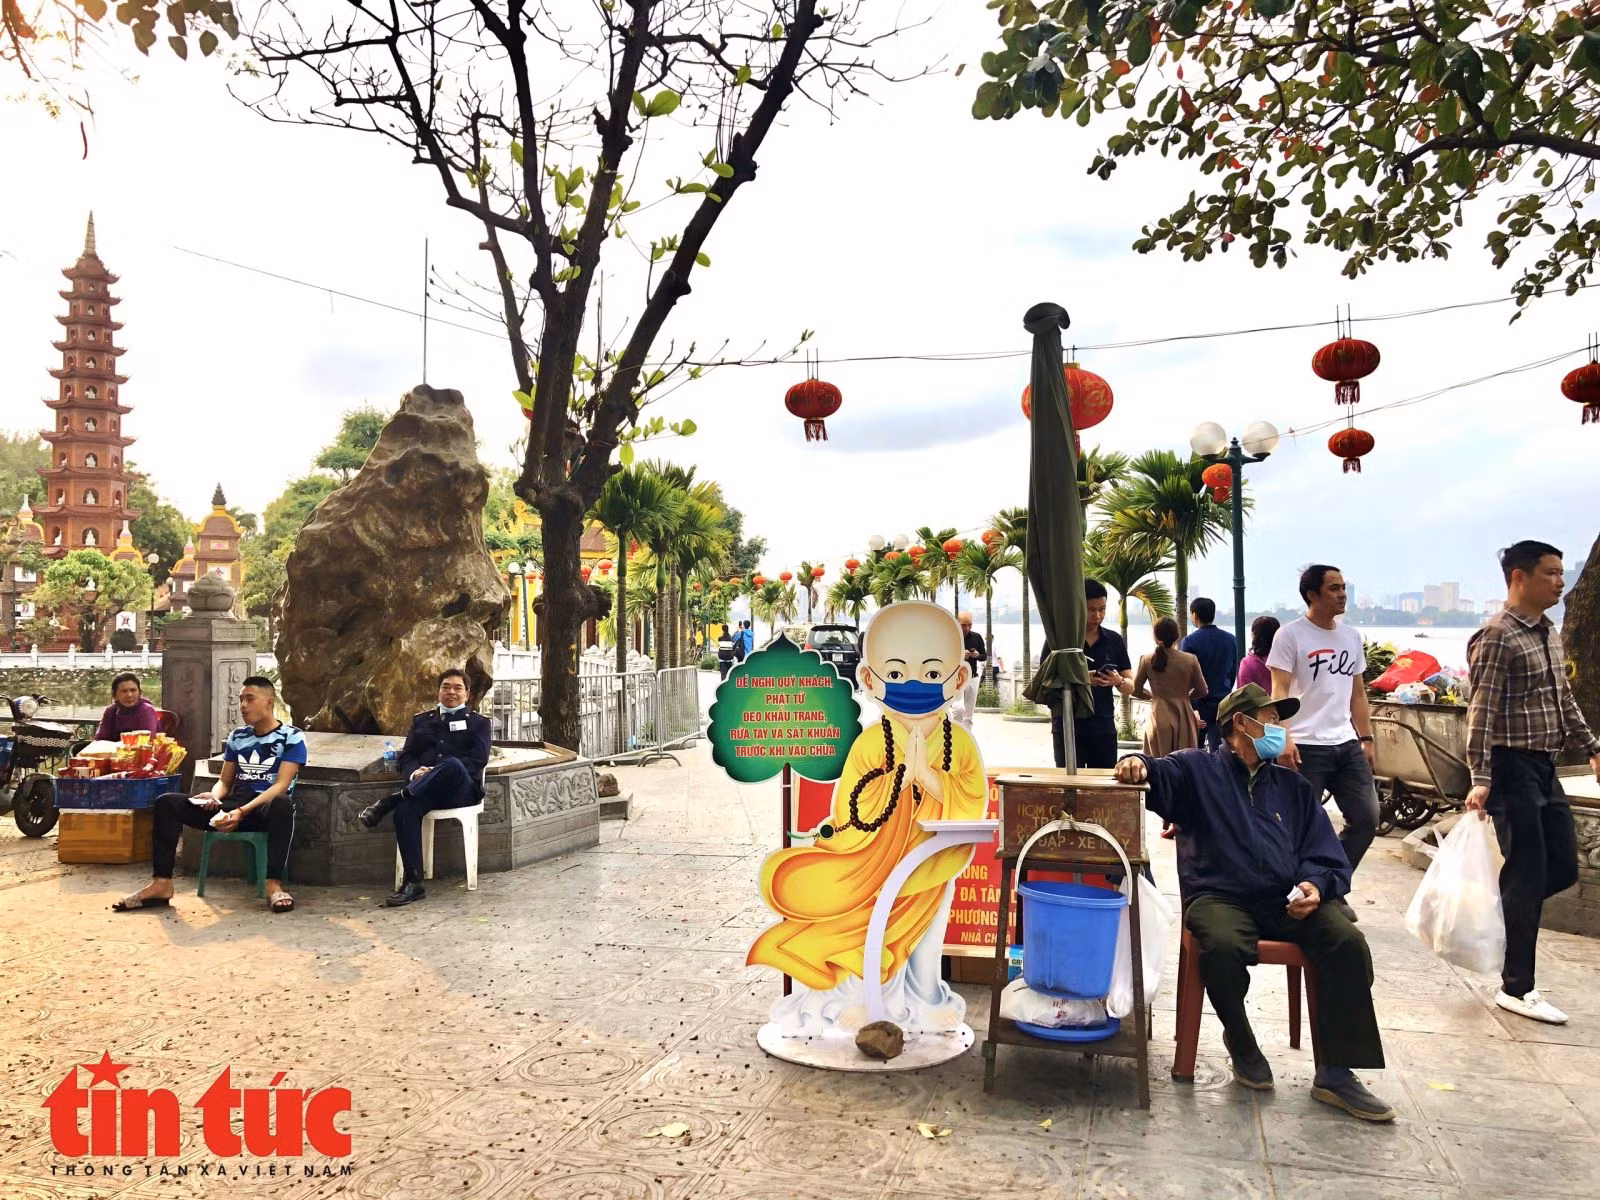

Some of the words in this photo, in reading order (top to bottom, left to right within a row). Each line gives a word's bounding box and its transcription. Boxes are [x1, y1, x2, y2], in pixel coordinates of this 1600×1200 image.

[751, 676, 775, 690] NGHỊ
[777, 675, 796, 689] QUÝ
[743, 710, 762, 722] ĐEO
[793, 710, 828, 723] TRANG,
[753, 728, 768, 740] TAY
[787, 726, 804, 739] SÁT
[735, 743, 766, 757] TRƯỚC
[769, 745, 785, 757] KHI
[788, 744, 806, 757] VÀO
[809, 743, 836, 756] CHÙA
[1078, 836, 1096, 849] XE
[960, 884, 977, 902] ĐÁ
[961, 928, 981, 943] NHÀ
